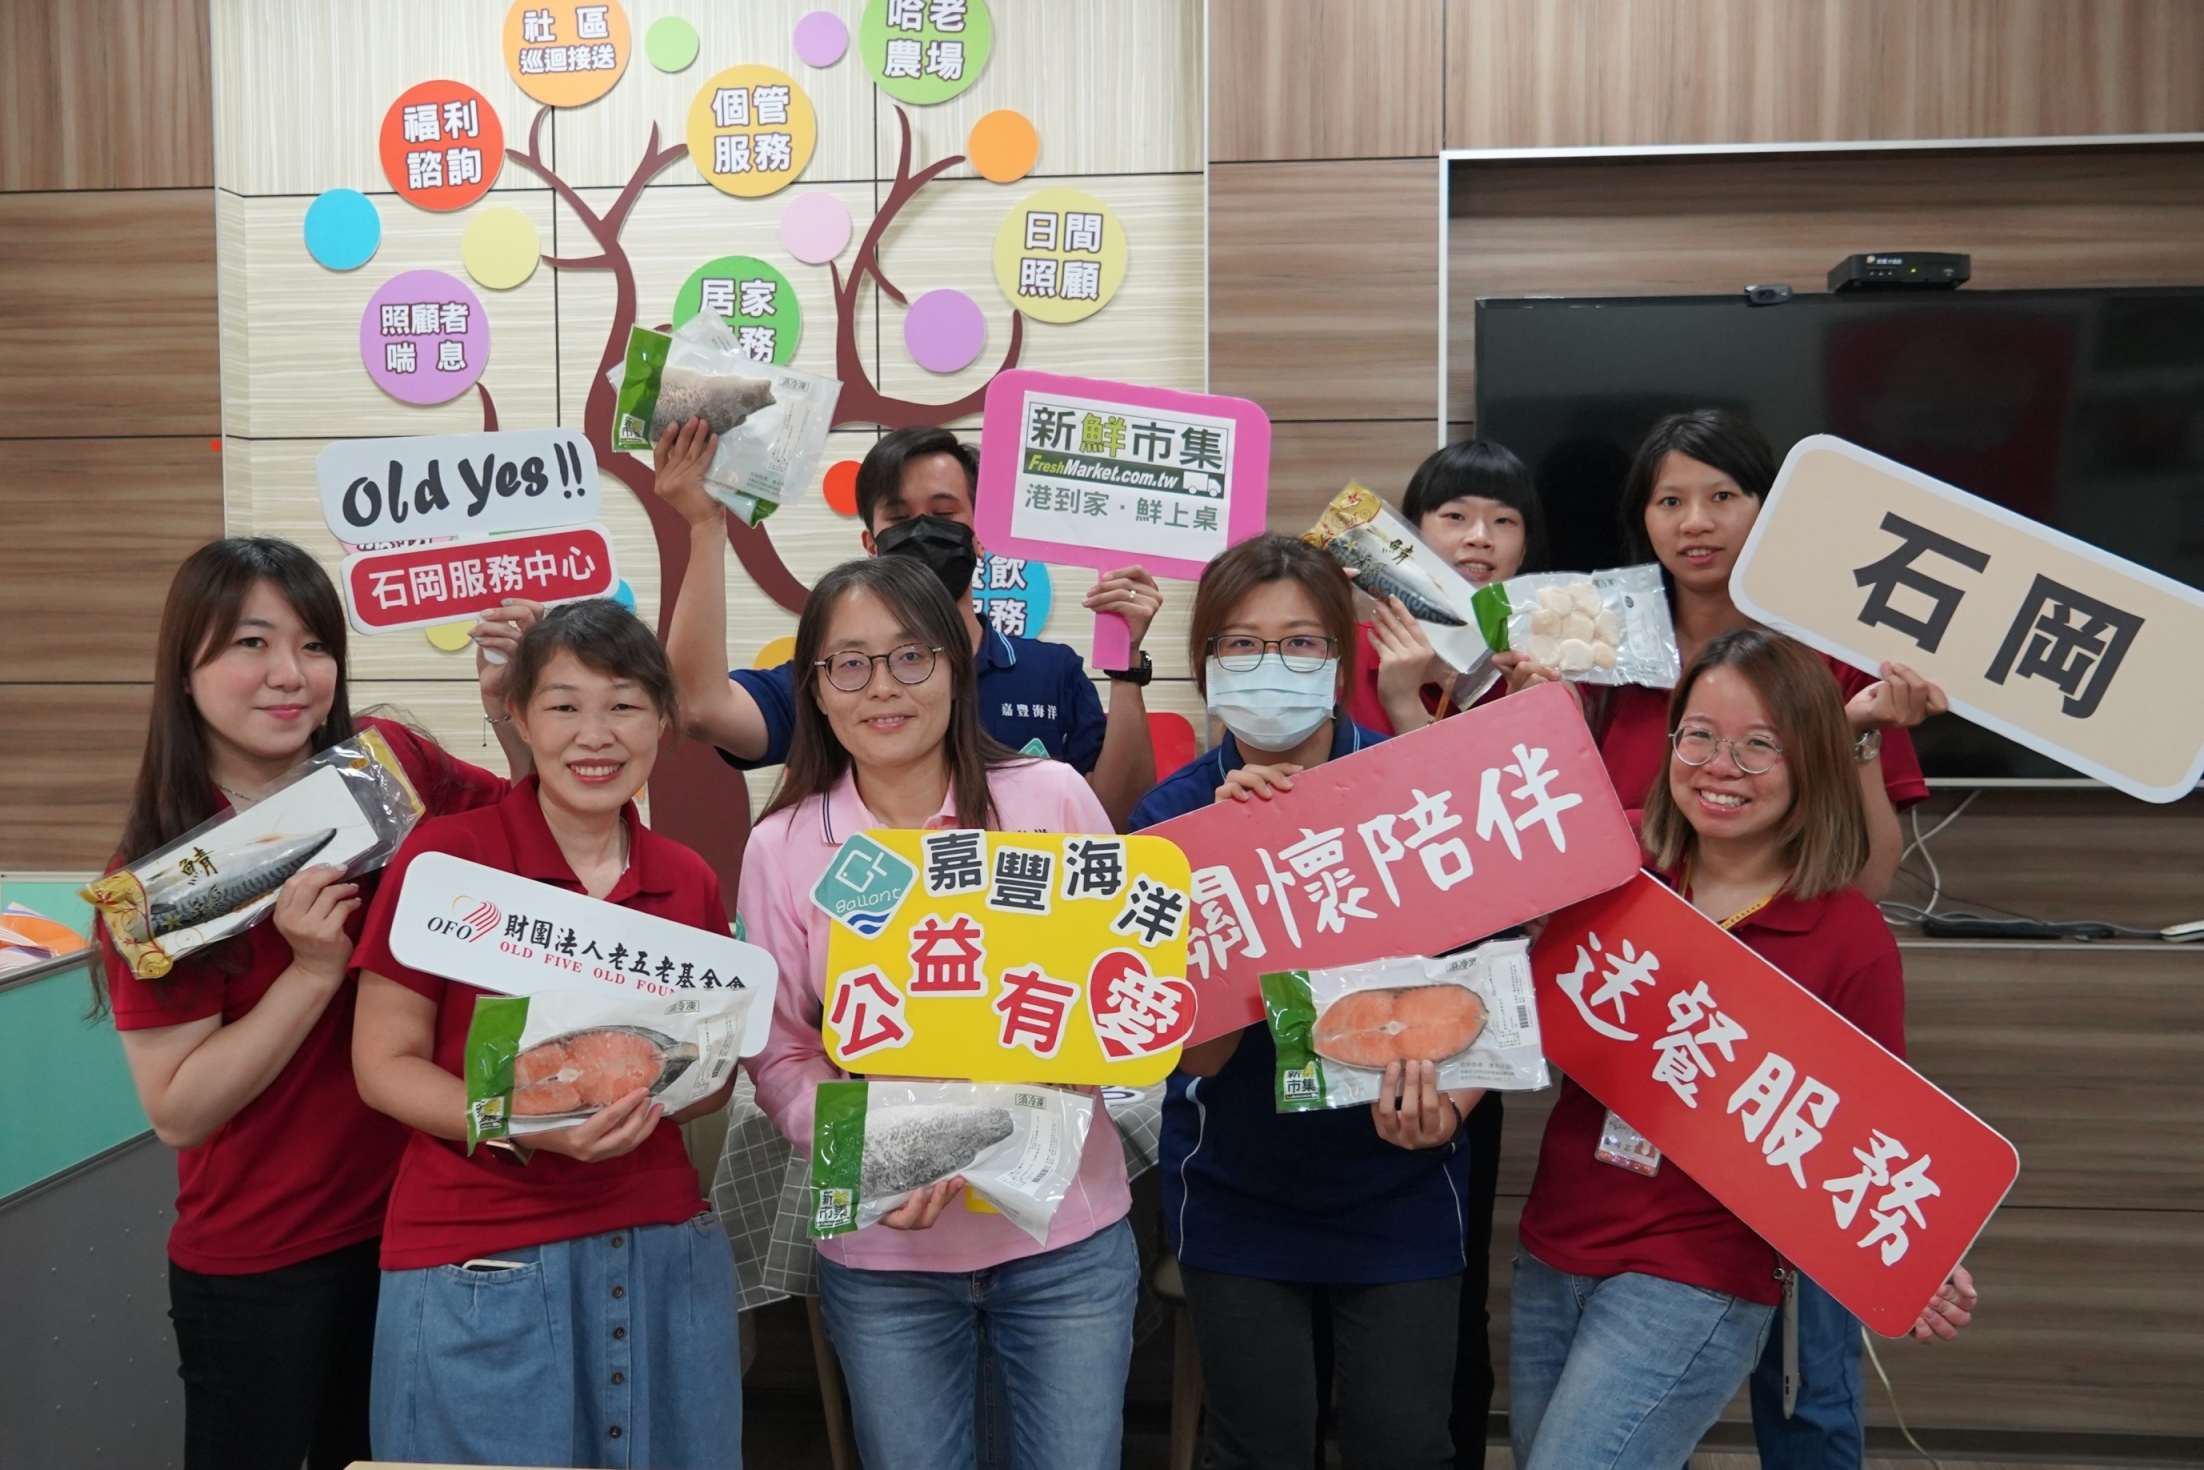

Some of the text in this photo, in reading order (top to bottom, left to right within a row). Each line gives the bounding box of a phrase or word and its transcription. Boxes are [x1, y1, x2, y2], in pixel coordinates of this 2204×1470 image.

[888, 0, 967, 32] 哈老
[520, 45, 616, 74] 巡迴接送
[884, 39, 965, 80] 農場
[403, 99, 479, 143] 福利
[711, 84, 791, 128] 個管
[407, 148, 483, 189] 諮詢
[713, 132, 792, 174] 服務
[1024, 211, 1103, 253] 日間
[699, 278, 777, 318] 居家
[1018, 257, 1101, 301] 照顧
[380, 301, 470, 336] 照顧者
[731, 325, 776, 364] 務
[1030, 406, 1223, 470] 新鮮市集
[1028, 454, 1178, 489] FreshMarket.com.tw
[342, 460, 450, 527] Old
[368, 546, 596, 609] 石岡服務中心
[972, 599, 1027, 637] 務
[1852, 511, 2146, 719] 石岡
[1001, 703, 1058, 719] 嘉豐海洋
[1187, 743, 1583, 981] 關懷陪伴
[926, 832, 1183, 943] 嘉豐海洋
[427, 917, 472, 940] OFO
[500, 941, 533, 959] OLD
[544, 953, 582, 973] FIVE
[593, 967, 626, 985] OLD
[828, 917, 1199, 1058] 公益有愛
[1287, 1078, 1317, 1093] 市集
[1556, 932, 1940, 1266] 送餐服務
